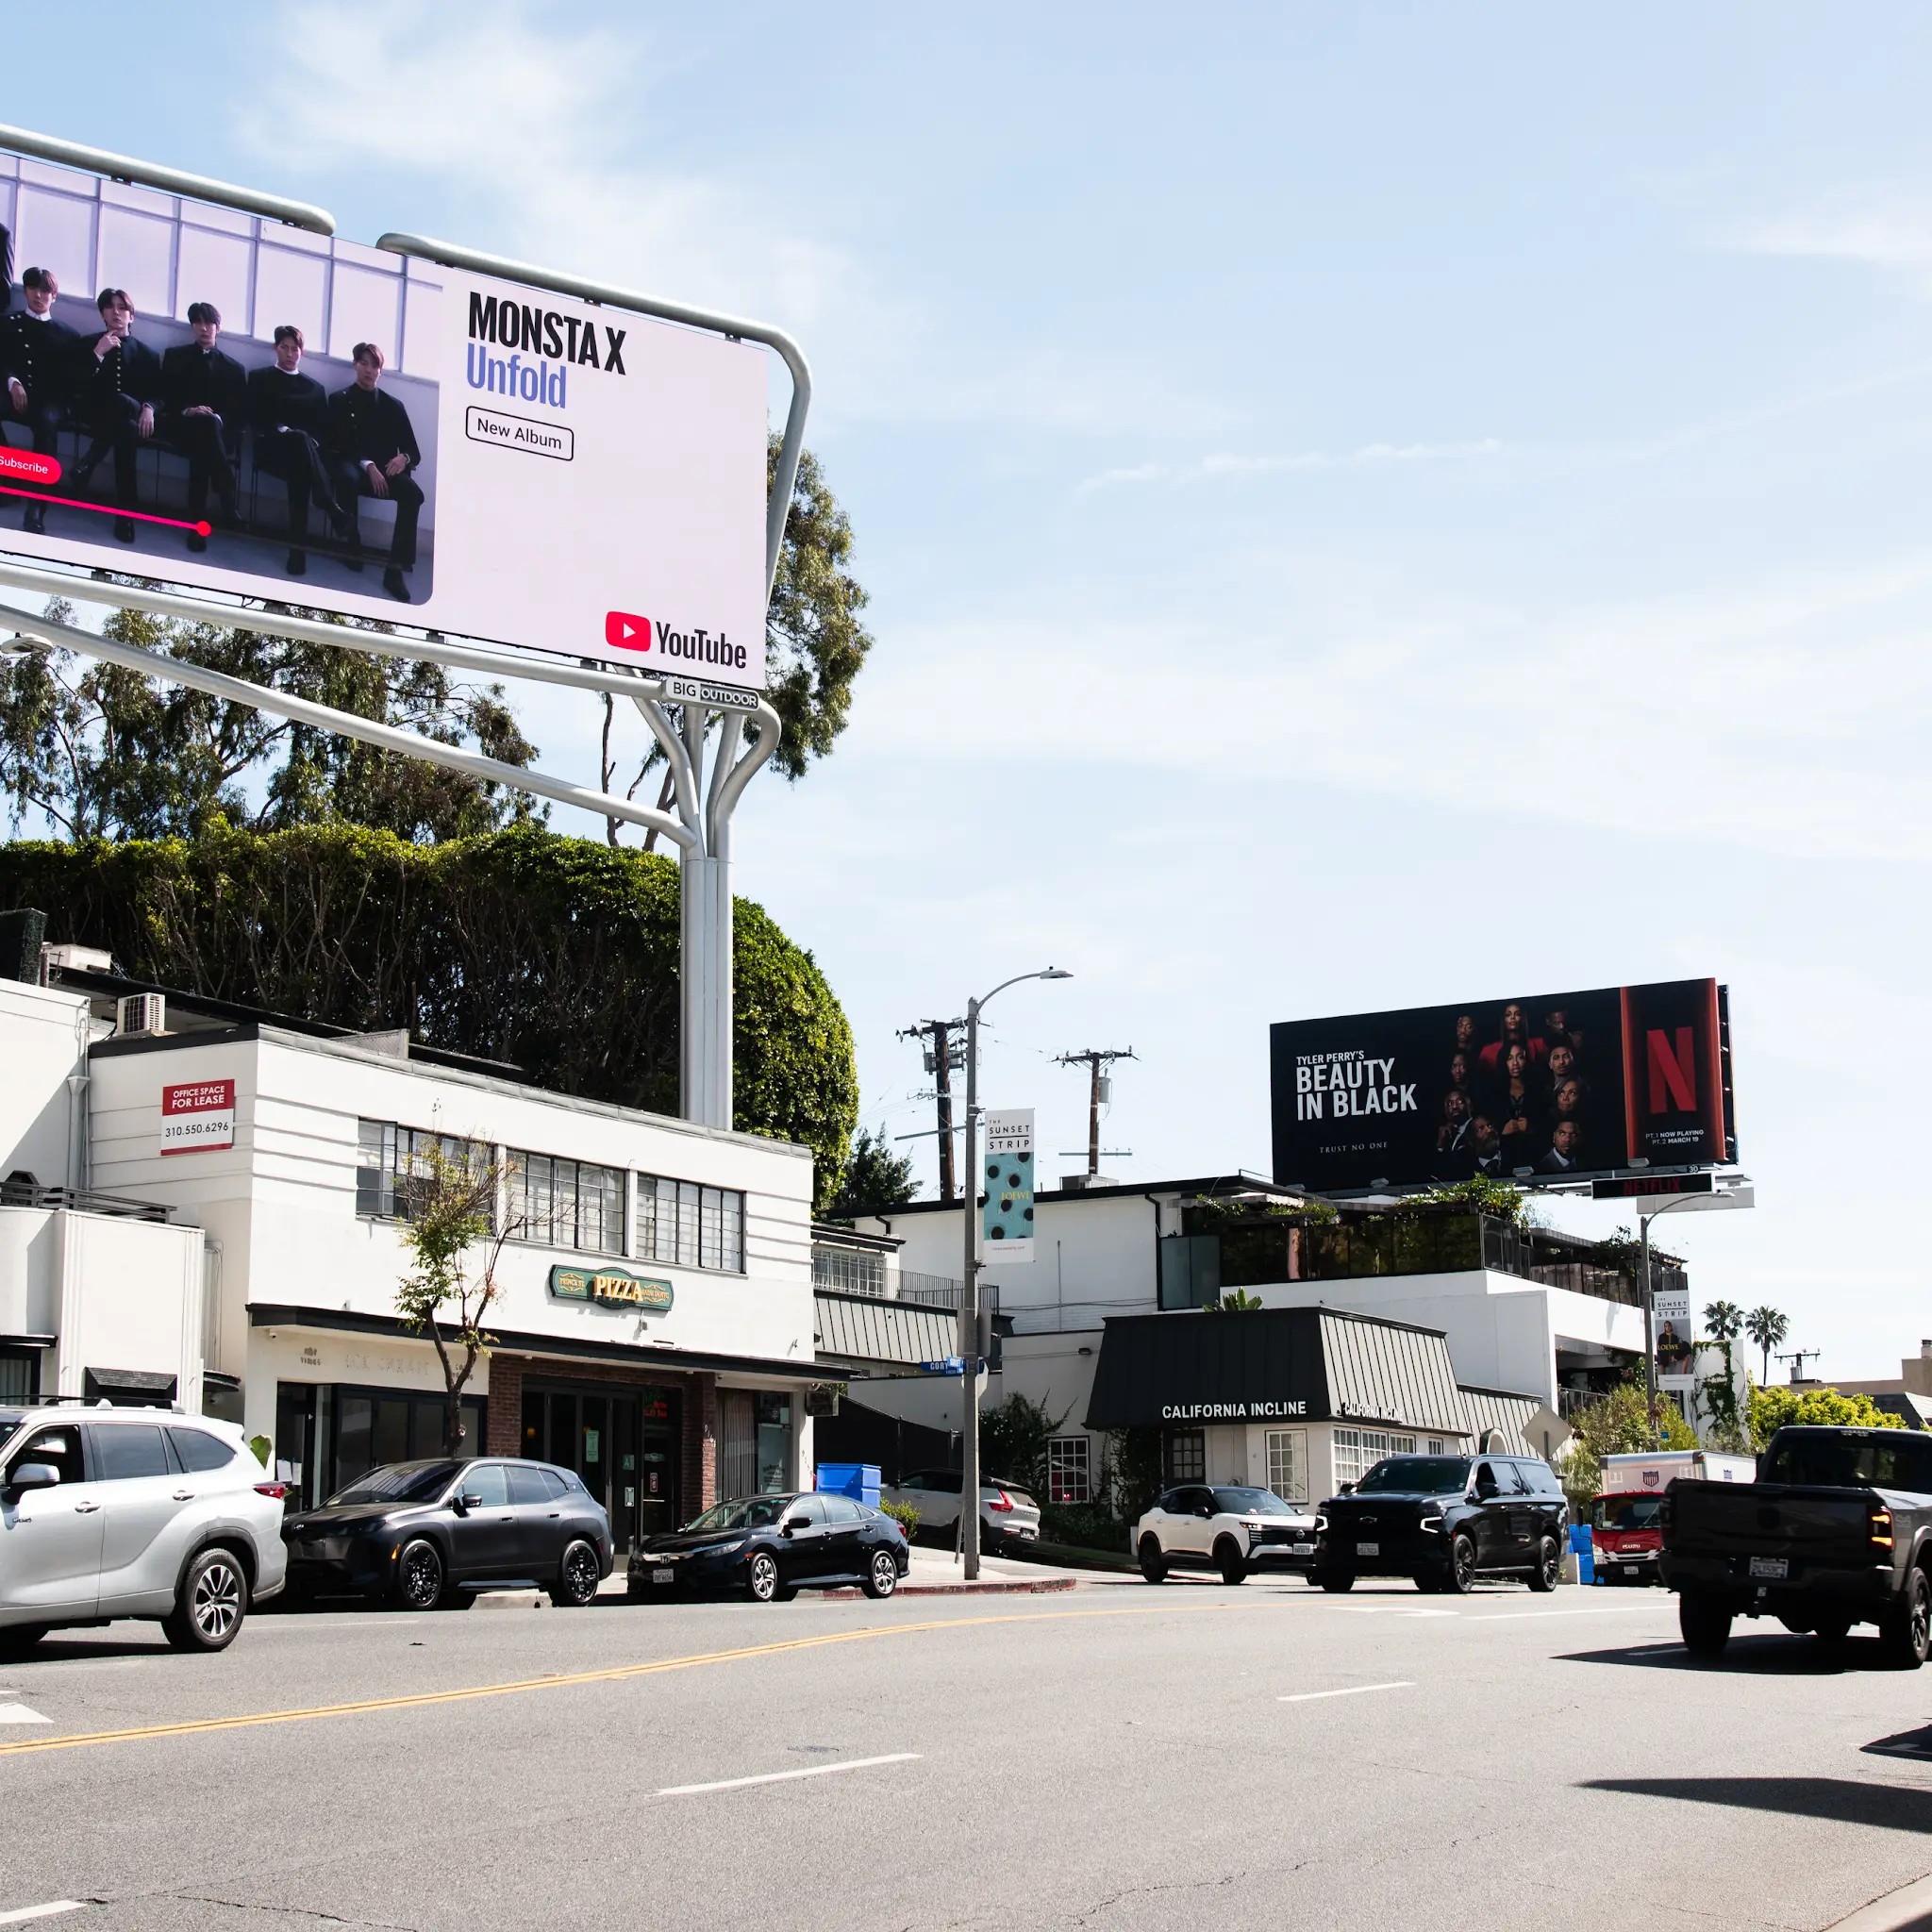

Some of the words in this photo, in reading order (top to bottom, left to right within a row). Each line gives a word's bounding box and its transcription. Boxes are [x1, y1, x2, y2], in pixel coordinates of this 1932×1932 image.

[468, 291, 599, 369] MONSTA
[605, 326, 626, 375] X
[467, 342, 566, 408] Unfold
[477, 418, 510, 439] New
[514, 427, 562, 450] Album
[0, 457, 48, 475] Subscribe
[656, 621, 747, 669] YouTube
[673, 682, 696, 696] BIG
[701, 689, 758, 707] OUTDOOR
[1296, 1054, 1324, 1066] TYLER
[1326, 1050, 1365, 1063] PERRY'S
[1296, 1058, 1395, 1093] BEAUTY
[173, 1088, 199, 1098] OFFICE
[200, 1086, 225, 1095] SPACE
[172, 1098, 192, 1109] FOR
[194, 1094, 225, 1107] LEASE
[1297, 1092, 1323, 1121] IN
[1333, 1084, 1418, 1118] BLACK
[165, 1122, 229, 1138] 310.550.6296
[989, 1125, 1029, 1135] SUNSET
[989, 1140, 1030, 1150] STRIP
[1319, 1144, 1348, 1154] TRUST
[1352, 1142, 1365, 1151] NO
[1370, 1141, 1389, 1150] ONE
[1624, 1176, 1682, 1195] NETFLIX
[593, 1274, 643, 1302] PIZZA
[929, 1361, 949, 1371] CORY
[1161, 1404, 1247, 1419] CALIFORNIA
[1251, 1401, 1307, 1417] INCLINE
